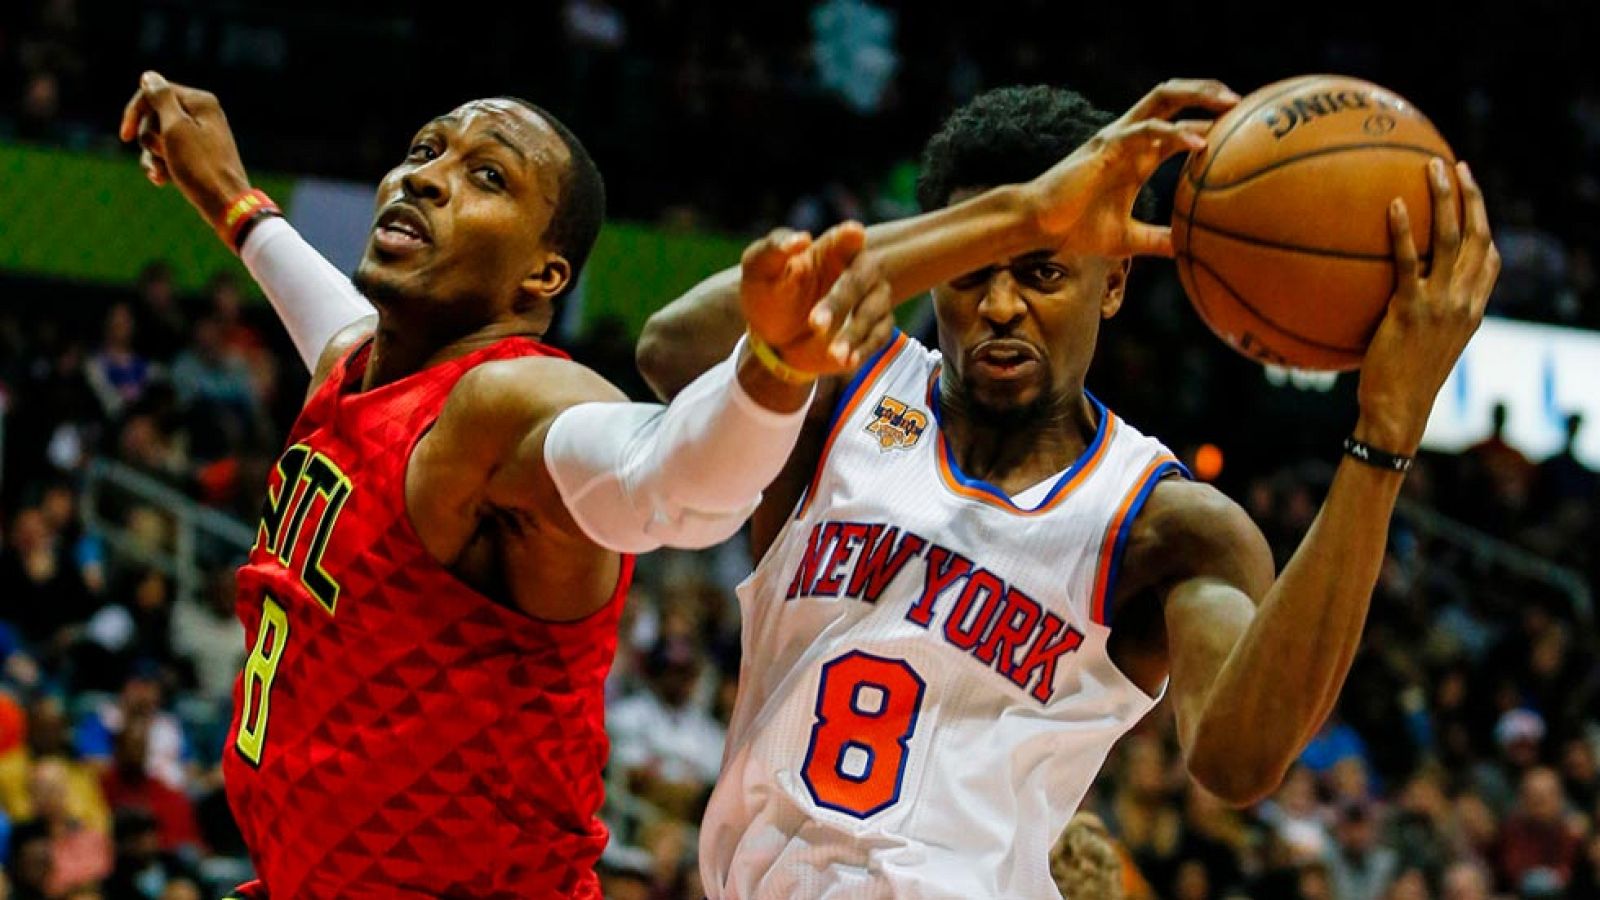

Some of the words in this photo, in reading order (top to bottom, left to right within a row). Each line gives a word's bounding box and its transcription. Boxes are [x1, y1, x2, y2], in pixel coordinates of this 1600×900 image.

[250, 443, 353, 617] ATL
[784, 520, 929, 604] NEW
[905, 543, 1085, 706] YORK
[236, 588, 289, 769] 8
[800, 648, 927, 820] 8
